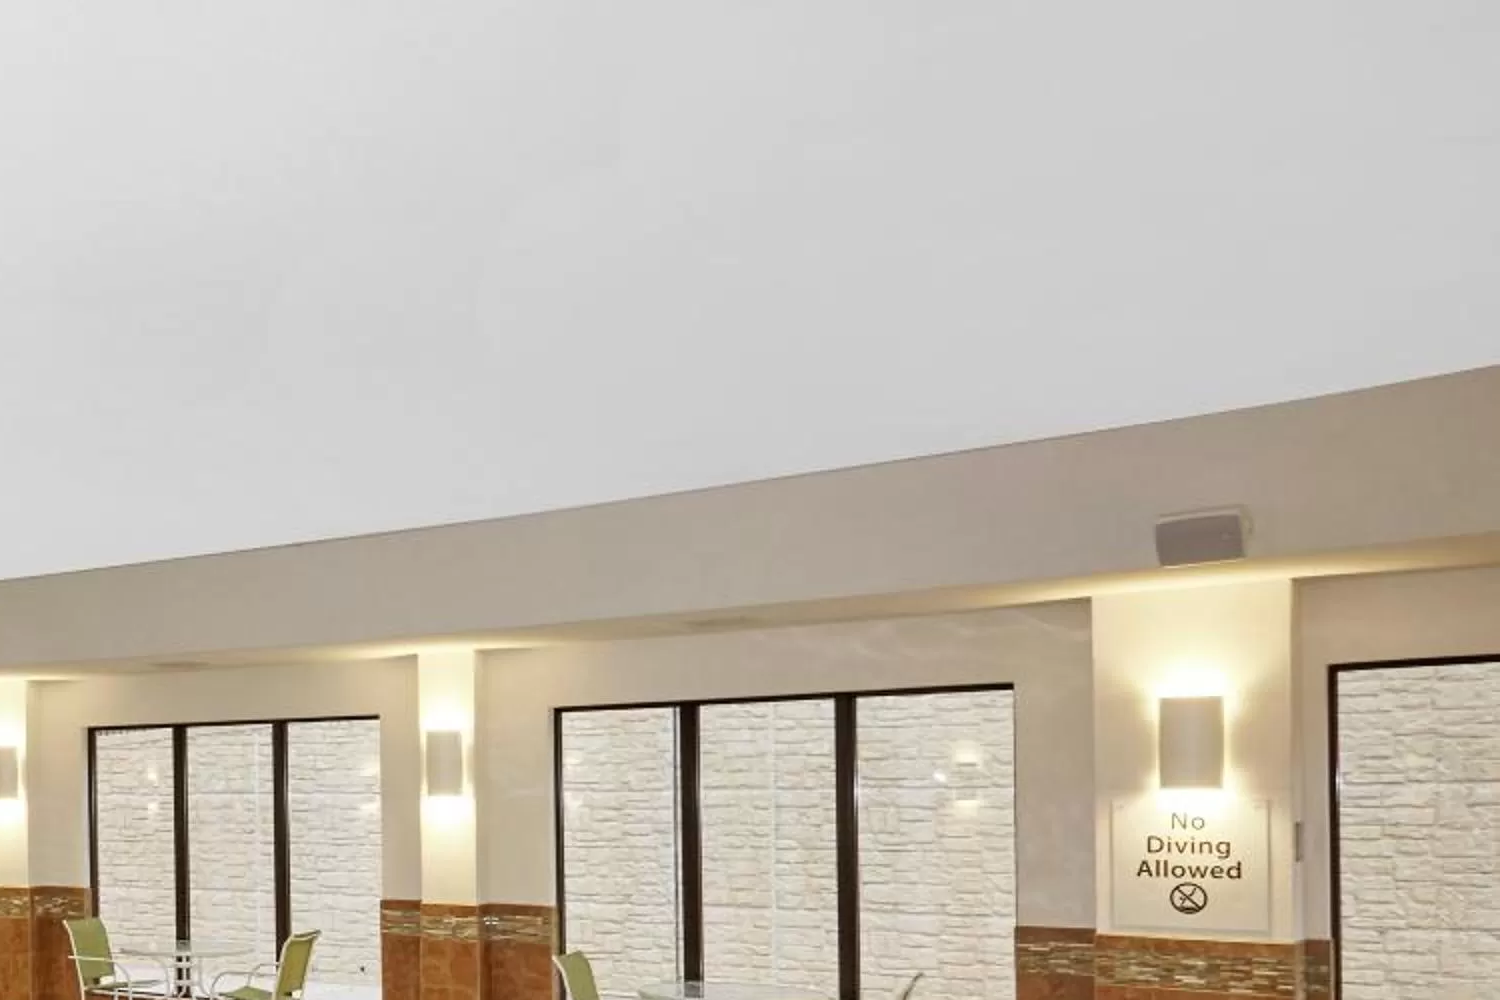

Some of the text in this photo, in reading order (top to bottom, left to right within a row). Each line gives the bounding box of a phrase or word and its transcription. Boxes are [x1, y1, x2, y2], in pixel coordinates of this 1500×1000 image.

[1171, 812, 1206, 831] No
[1146, 835, 1232, 859] Diving
[1136, 860, 1242, 879] Allowed
